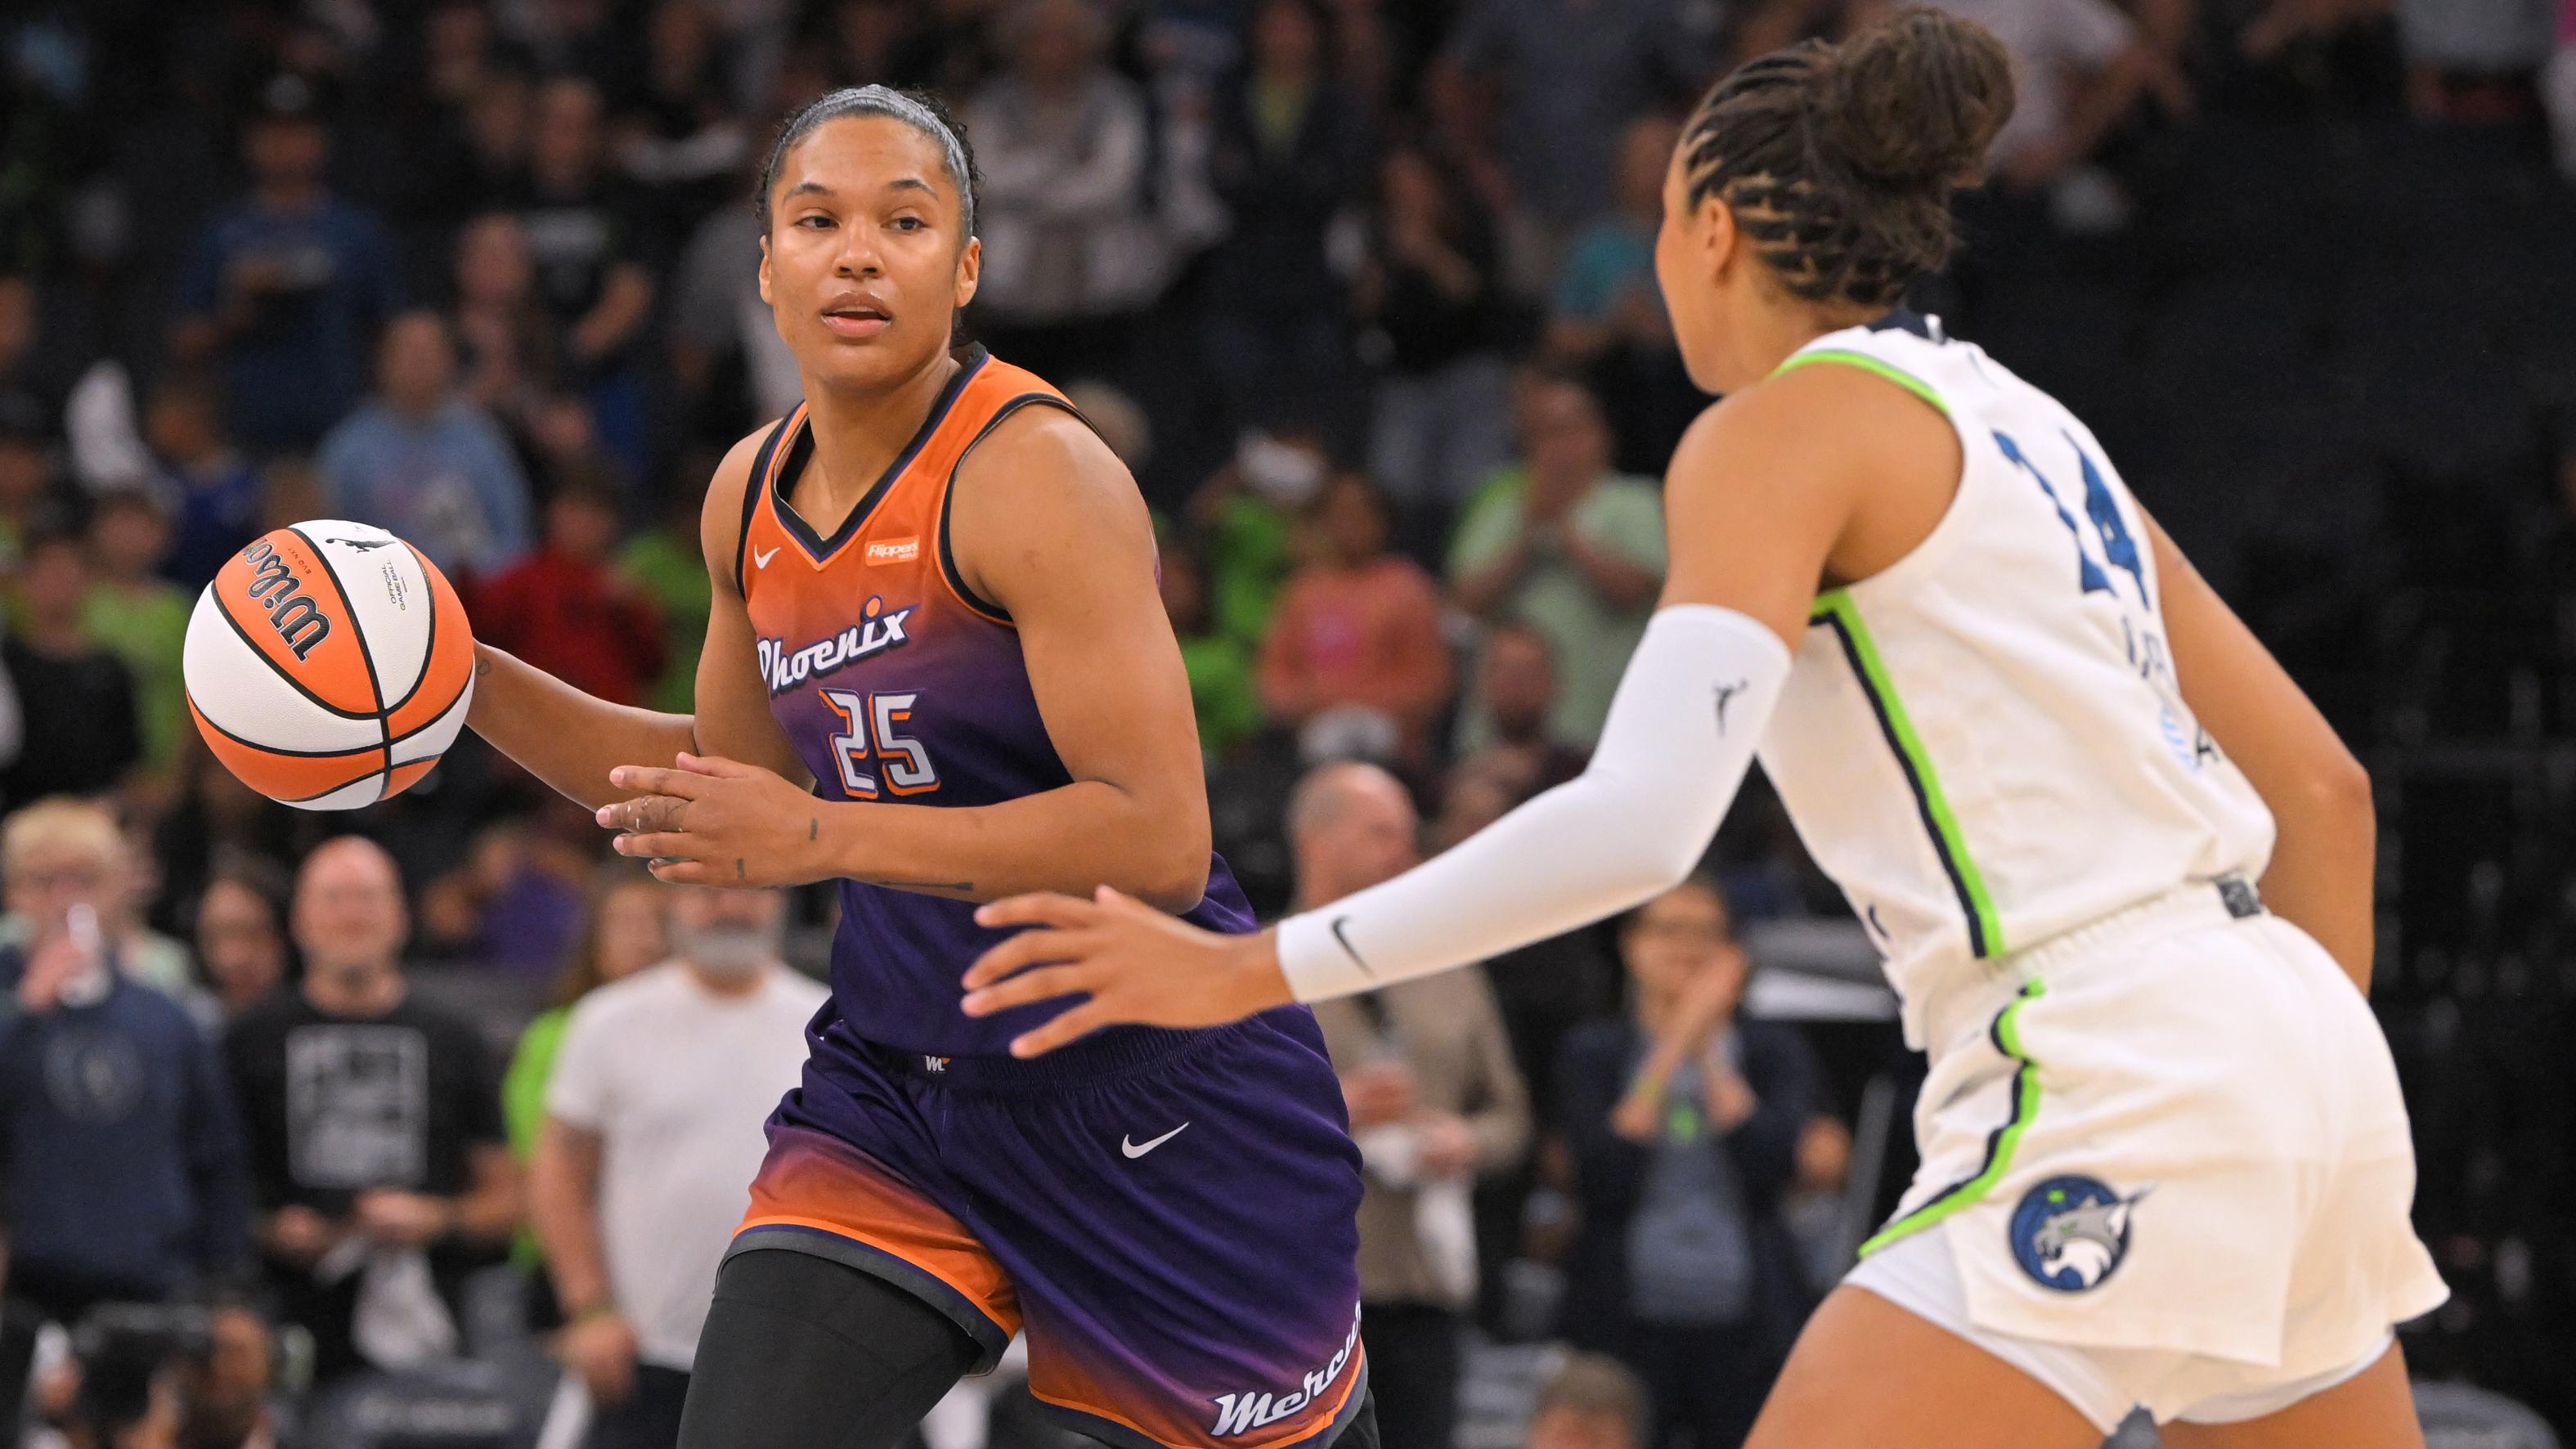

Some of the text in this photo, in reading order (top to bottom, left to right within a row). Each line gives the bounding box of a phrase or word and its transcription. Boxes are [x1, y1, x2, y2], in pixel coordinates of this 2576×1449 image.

[381, 564, 397, 604] OFFICIAL
[387, 559, 406, 611] GAME BALL
[756, 594, 922, 694] Phoenix
[818, 688, 940, 799] 25
